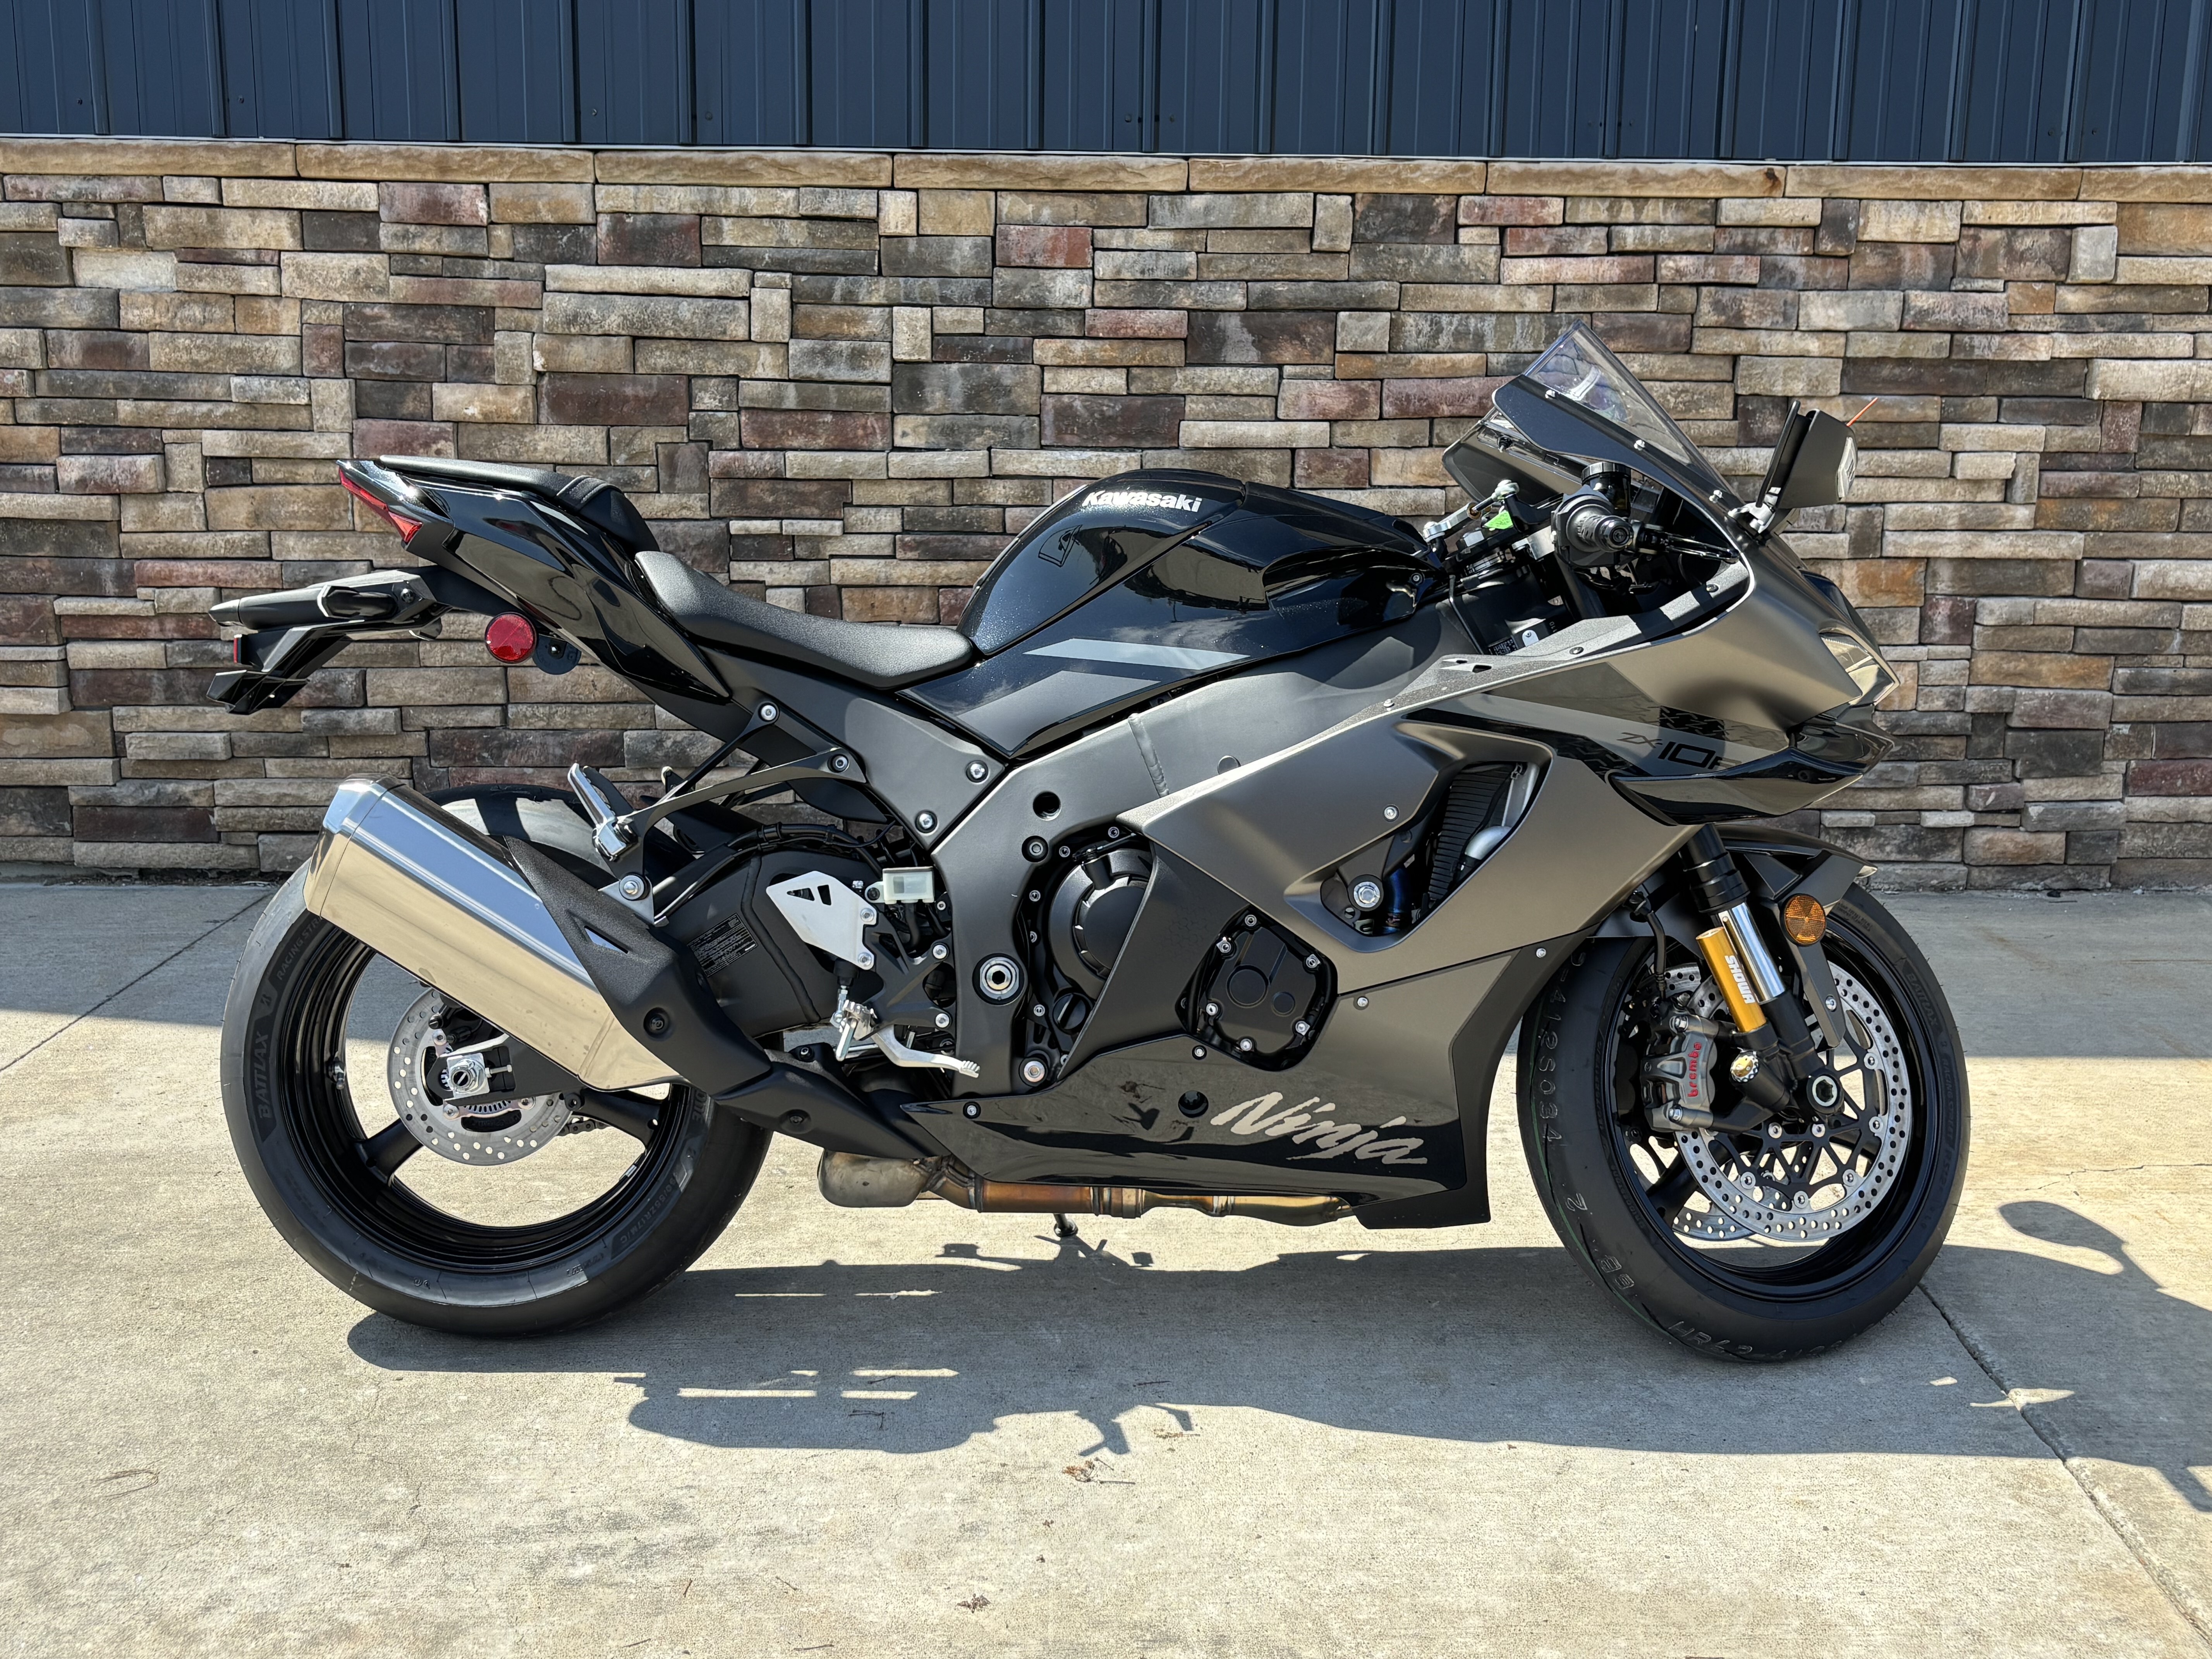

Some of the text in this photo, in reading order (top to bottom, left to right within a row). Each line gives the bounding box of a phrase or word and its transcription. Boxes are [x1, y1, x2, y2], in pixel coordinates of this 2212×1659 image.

[1082, 490, 1202, 512] Kawasaki
[1724, 955, 1755, 1004] SHOWA
[254, 1031, 271, 1119] BATTLAX
[1687, 1042, 1702, 1097] brembo
[1211, 1092, 1427, 1164] Ninja
